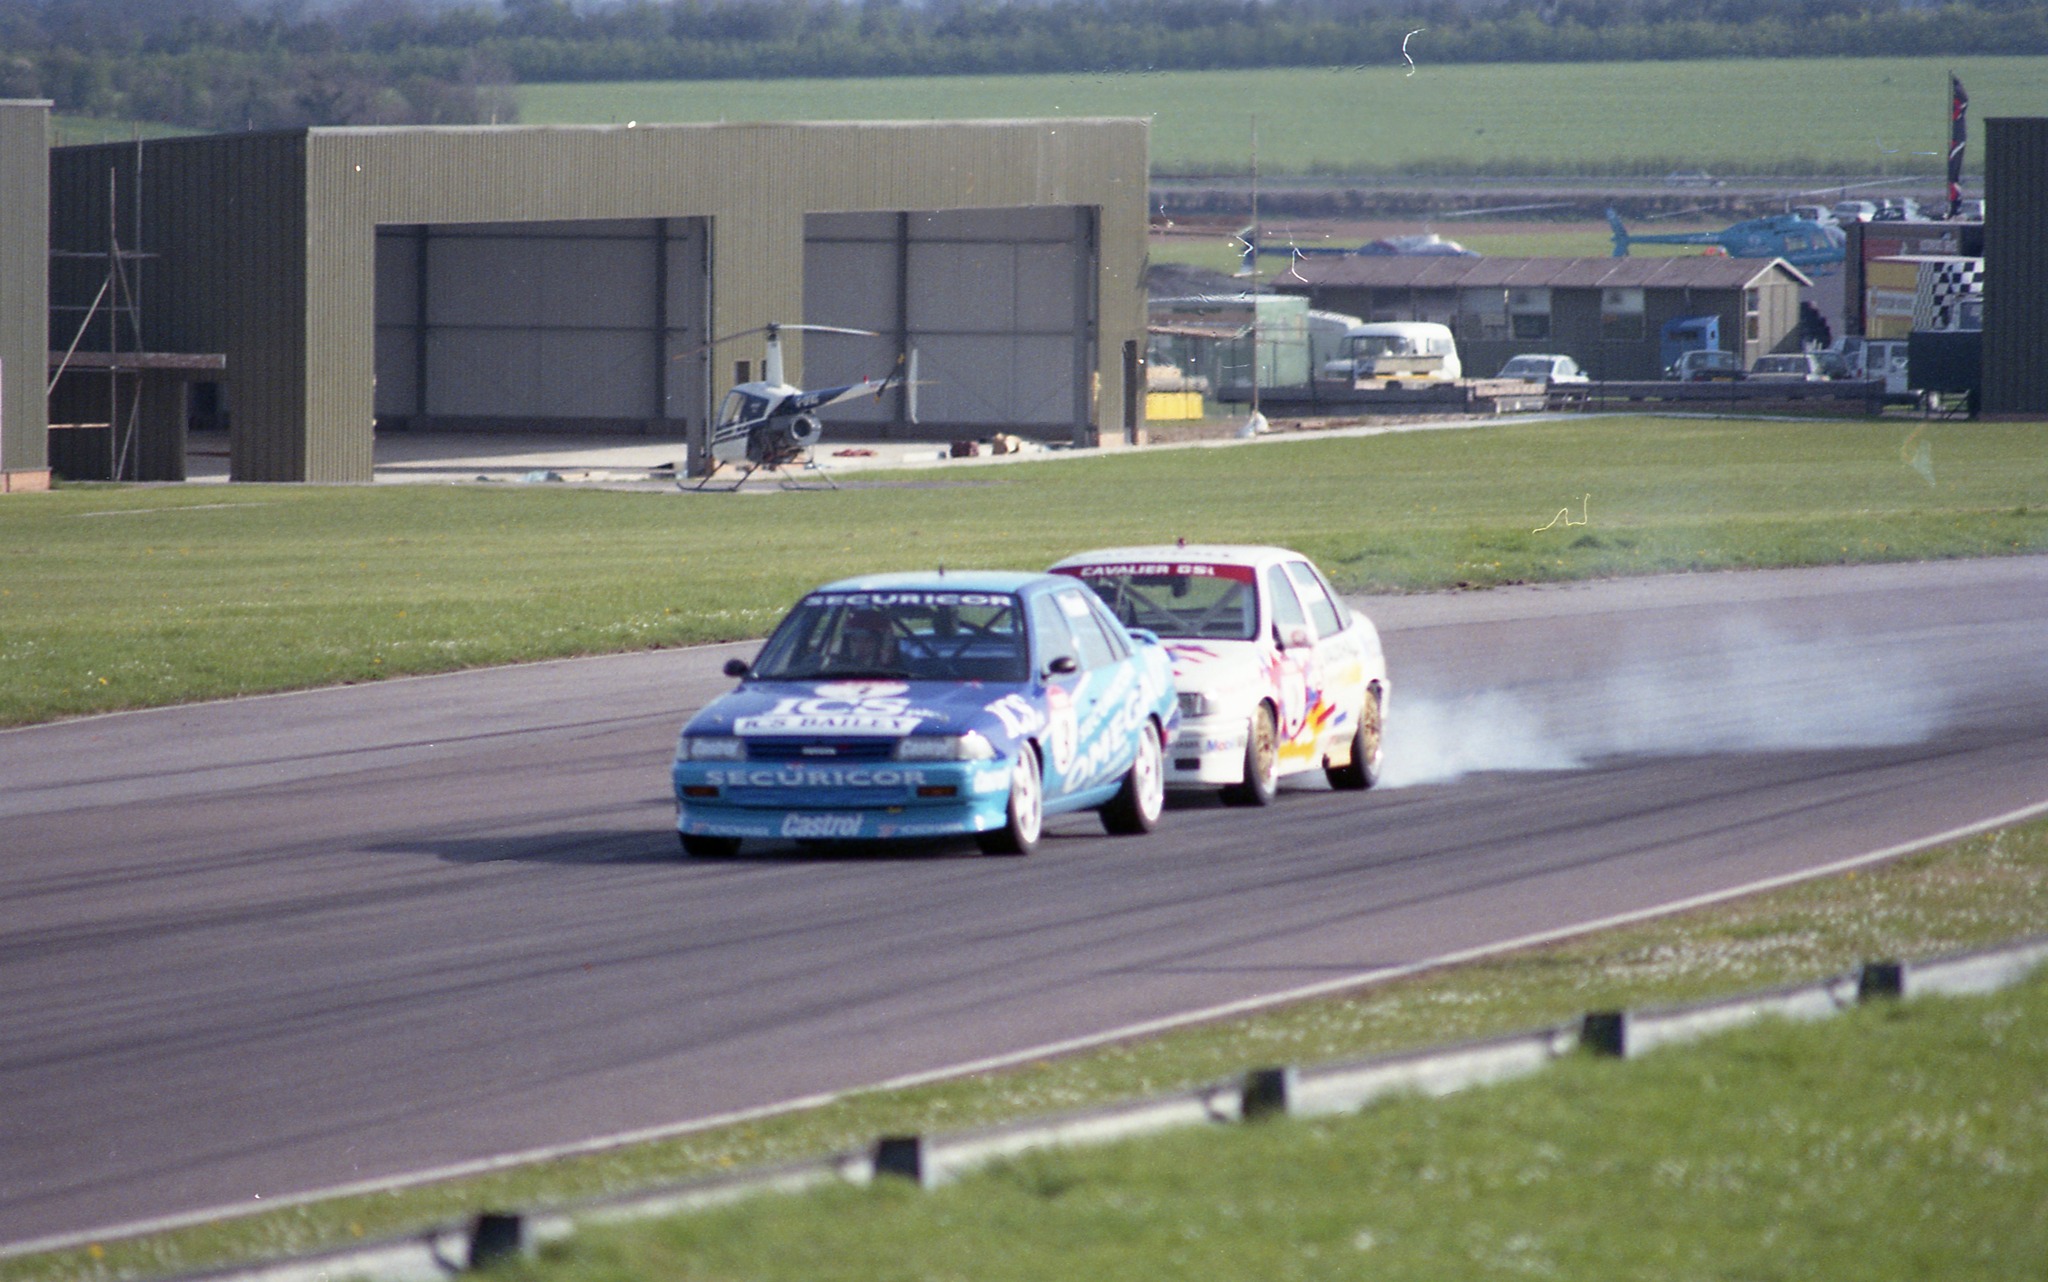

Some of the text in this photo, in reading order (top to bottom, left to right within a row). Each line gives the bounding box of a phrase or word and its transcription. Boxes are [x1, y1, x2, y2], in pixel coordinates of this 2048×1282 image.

[1080, 564, 1170, 577] CAVALIER
[804, 594, 1013, 607] SECURICOR
[705, 770, 927, 786] SECURICOR
[780, 812, 864, 838] Castrol
